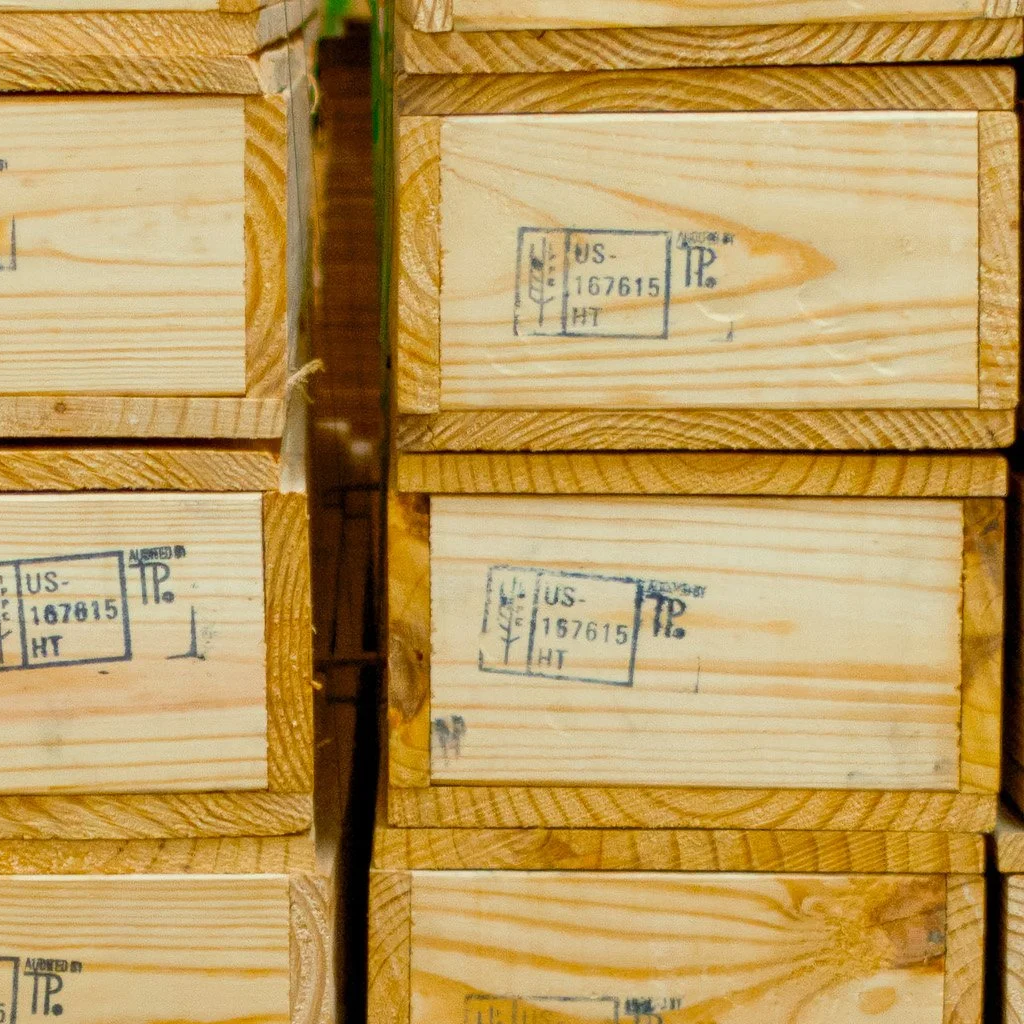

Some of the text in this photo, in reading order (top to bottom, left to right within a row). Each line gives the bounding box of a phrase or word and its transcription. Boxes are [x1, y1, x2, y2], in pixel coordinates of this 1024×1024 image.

[574, 243, 616, 264] US-
[575, 276, 660, 296] 167615
[572, 308, 602, 326] HT
[25, 572, 68, 594] US-
[544, 586, 585, 607] US-
[31, 599, 118, 625] 167615
[543, 618, 628, 645] 167615
[32, 635, 62, 658] HT
[538, 648, 567, 670] HT
